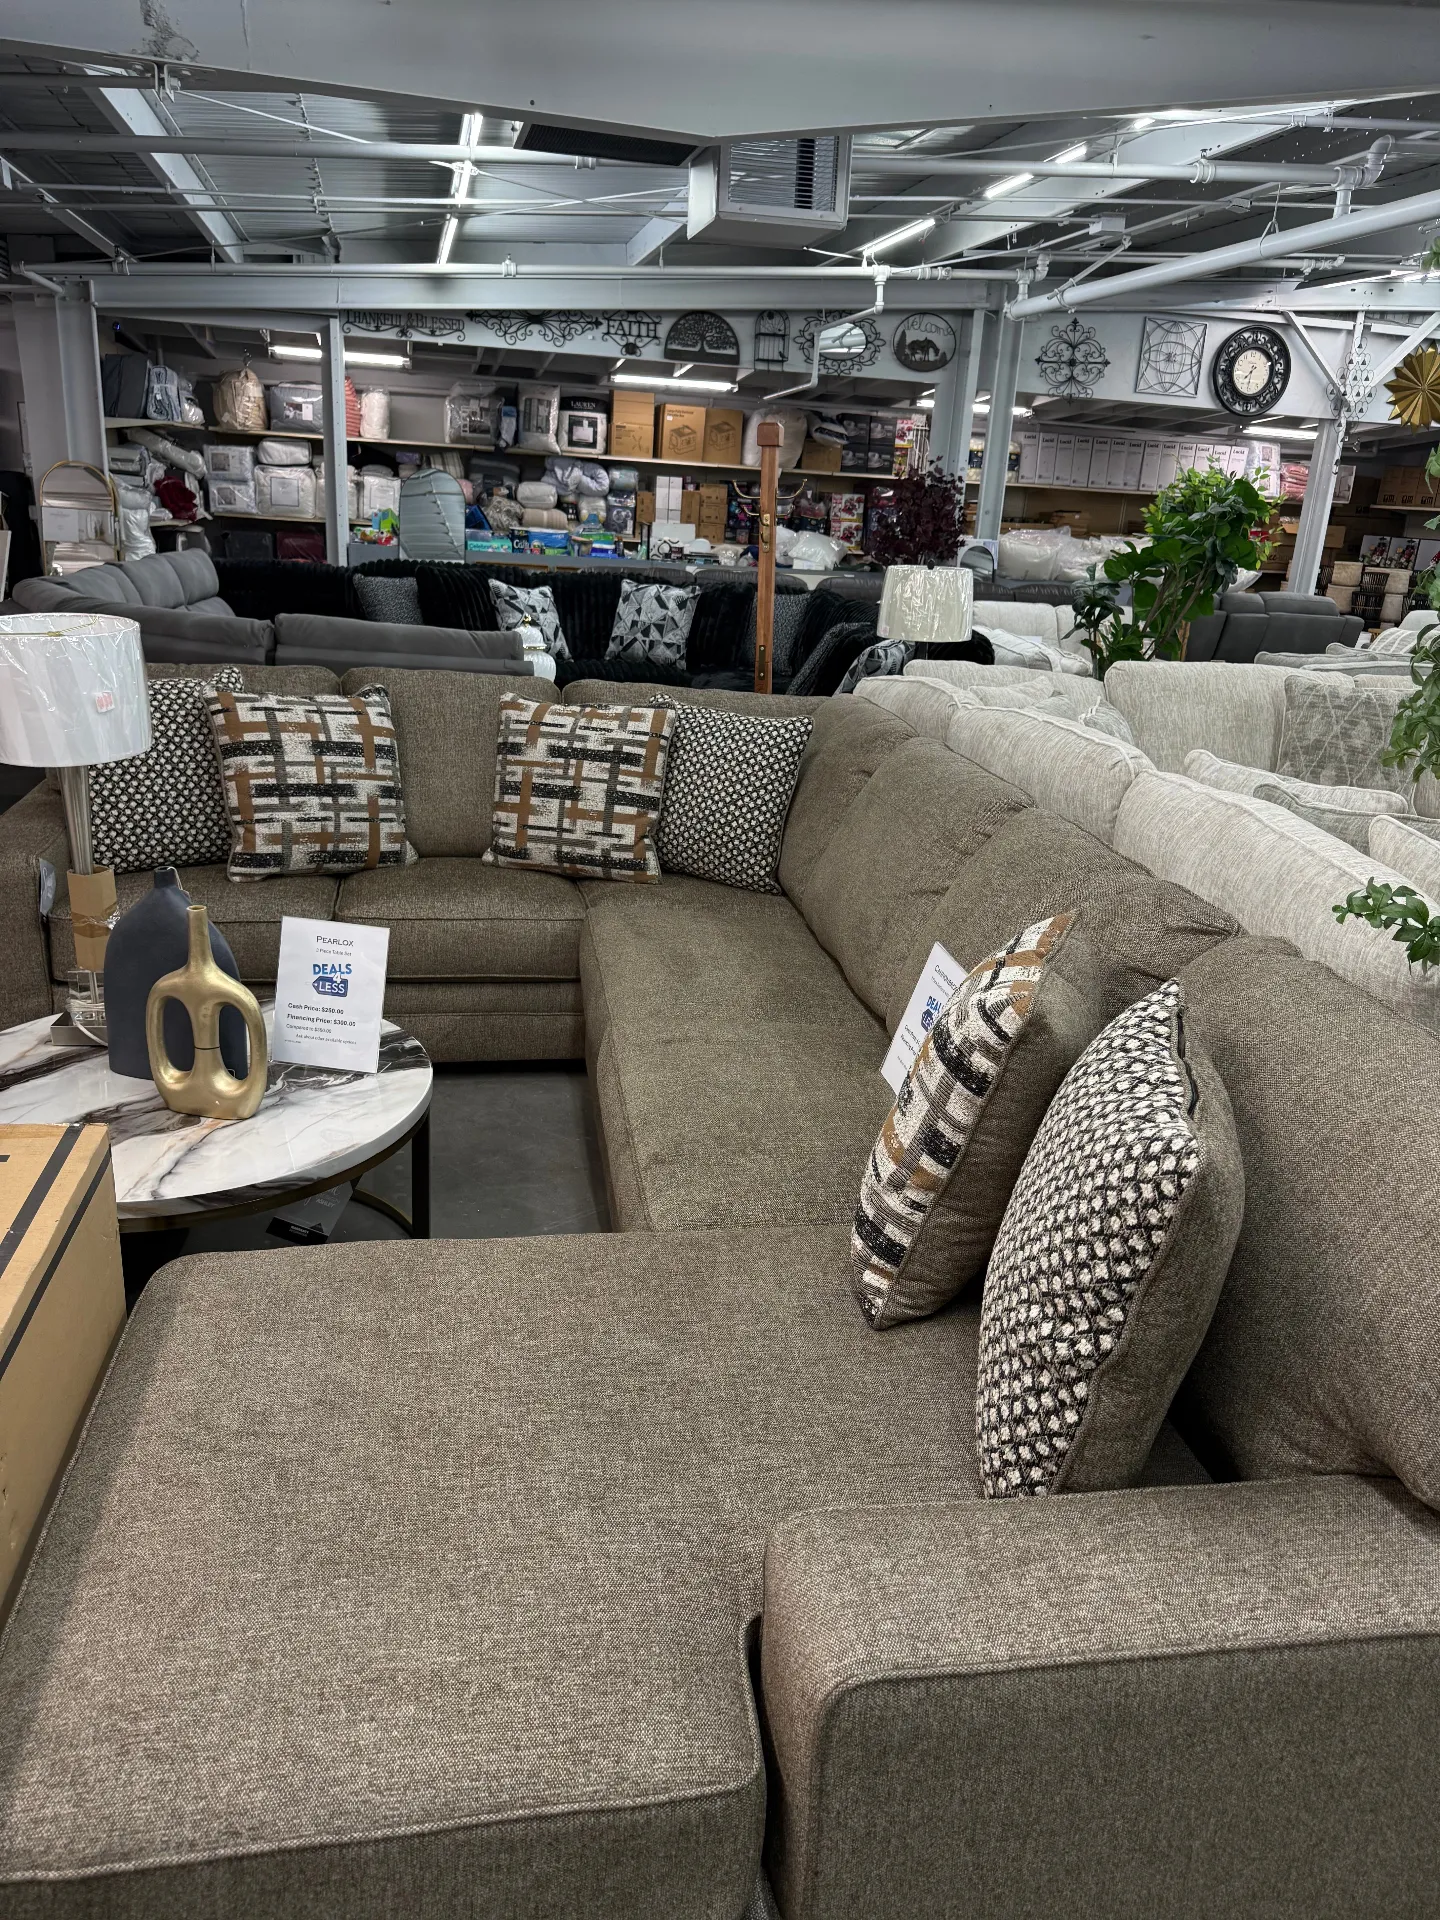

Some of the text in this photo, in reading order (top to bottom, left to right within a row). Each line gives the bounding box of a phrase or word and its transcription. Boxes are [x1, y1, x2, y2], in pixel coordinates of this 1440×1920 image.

[415, 312, 465, 331] BLESSED
[603, 318, 661, 339] FAITH
[316, 935, 354, 947] PEARLOX
[312, 963, 353, 975] DEALS
[332, 971, 342, 984] 4
[319, 981, 345, 994] LESS
[287, 1002, 303, 1010] Cash
[303, 1004, 321, 1012] Price:
[286, 1013, 315, 1023] Financing
[315, 1016, 333, 1025] Price:
